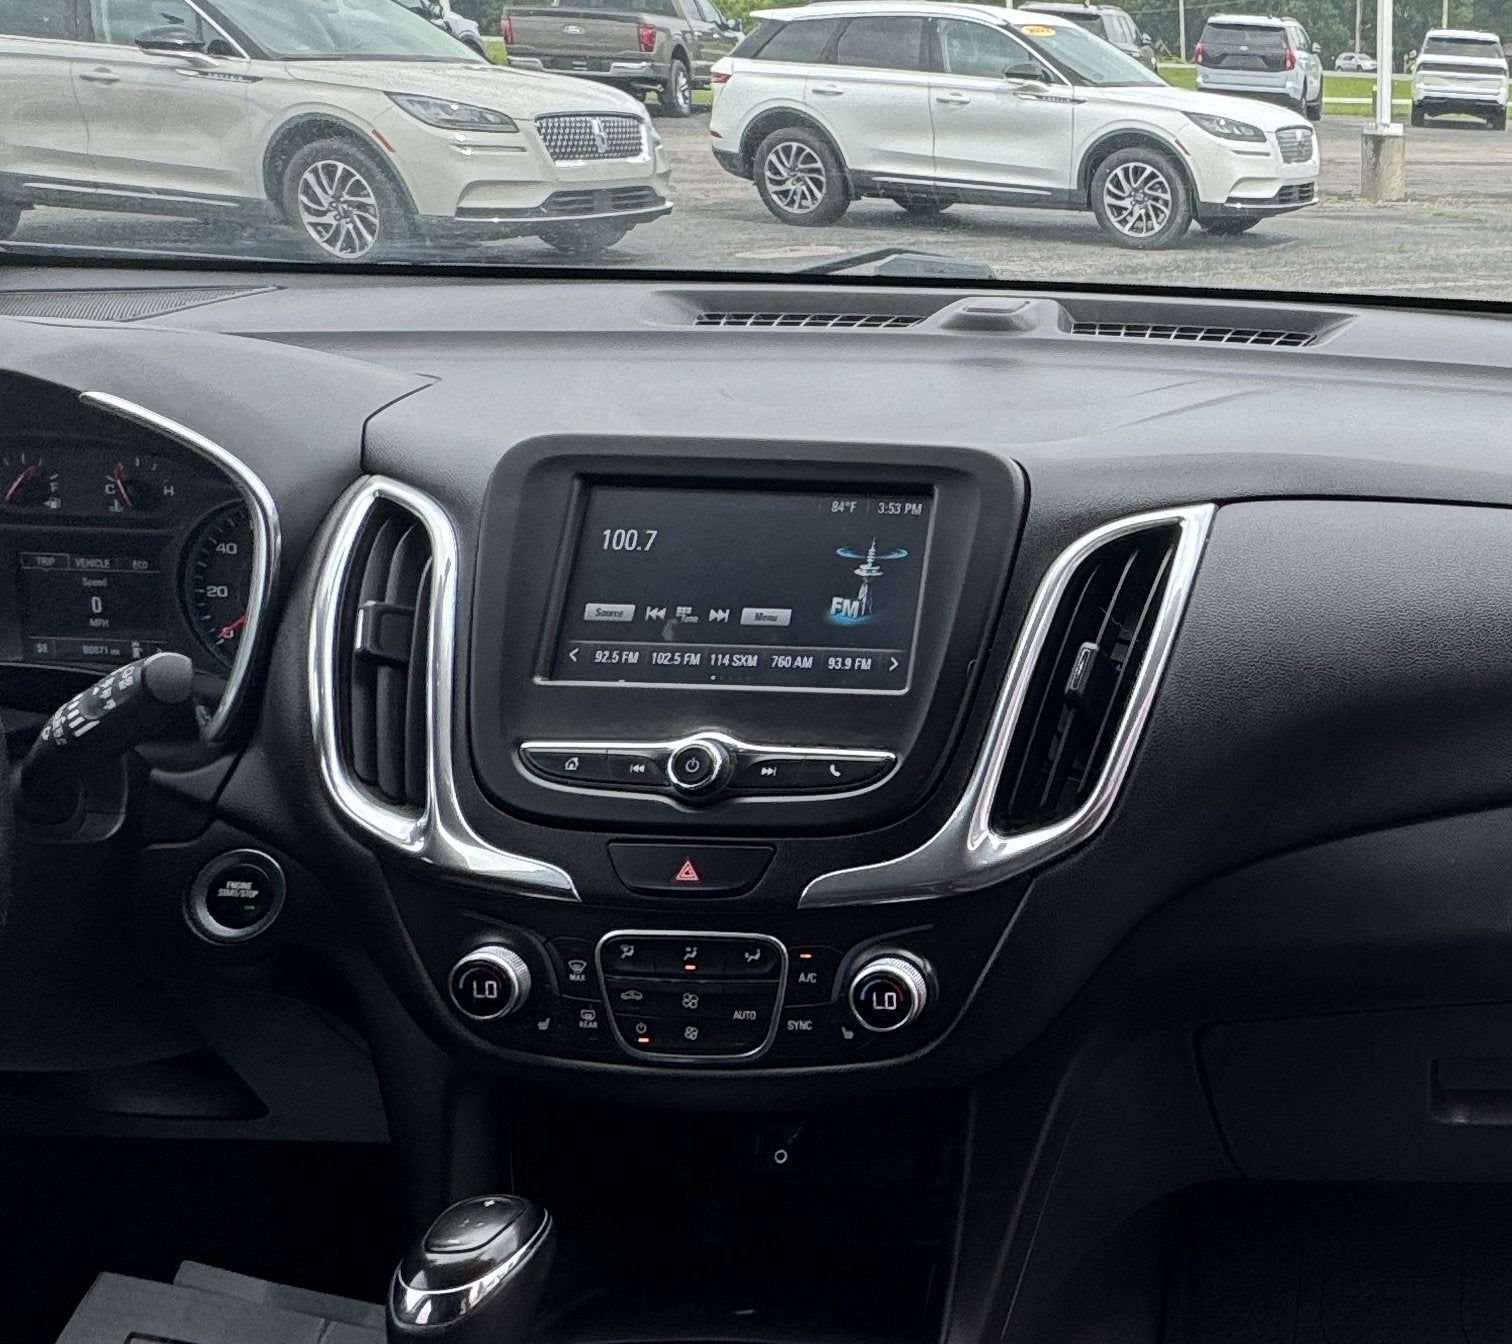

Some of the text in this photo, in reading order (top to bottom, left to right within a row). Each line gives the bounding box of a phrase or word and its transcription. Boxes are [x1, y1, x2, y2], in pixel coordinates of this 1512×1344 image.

[50, 482, 59, 493] F
[105, 483, 116, 495] C
[163, 485, 175, 496] H
[831, 500, 857, 514] 84°F
[877, 502, 923, 517] 3:53 PM
[601, 528, 659, 553] 100.7
[215, 542, 238, 555] 40
[36, 556, 56, 567] TRIP
[74, 558, 111, 569] VEHICLE
[132, 559, 149, 571] ECO
[206, 585, 228, 598] 20
[91, 596, 103, 614] 0
[594, 607, 626, 619] Source
[753, 612, 779, 623] Menu
[36, 643, 49, 654] SE
[595, 649, 640, 665] 92.5 FM
[651, 651, 701, 667] 102.5 FM
[709, 653, 758, 668] 114 SXM
[771, 655, 813, 670] 760 AM
[827, 657, 872, 671] 93.9 FM
[798, 972, 818, 984] A/C
[473, 981, 498, 999] LO
[872, 991, 897, 1010] LO
[732, 1010, 757, 1021] AUTO
[787, 1019, 813, 1031] SYNC
